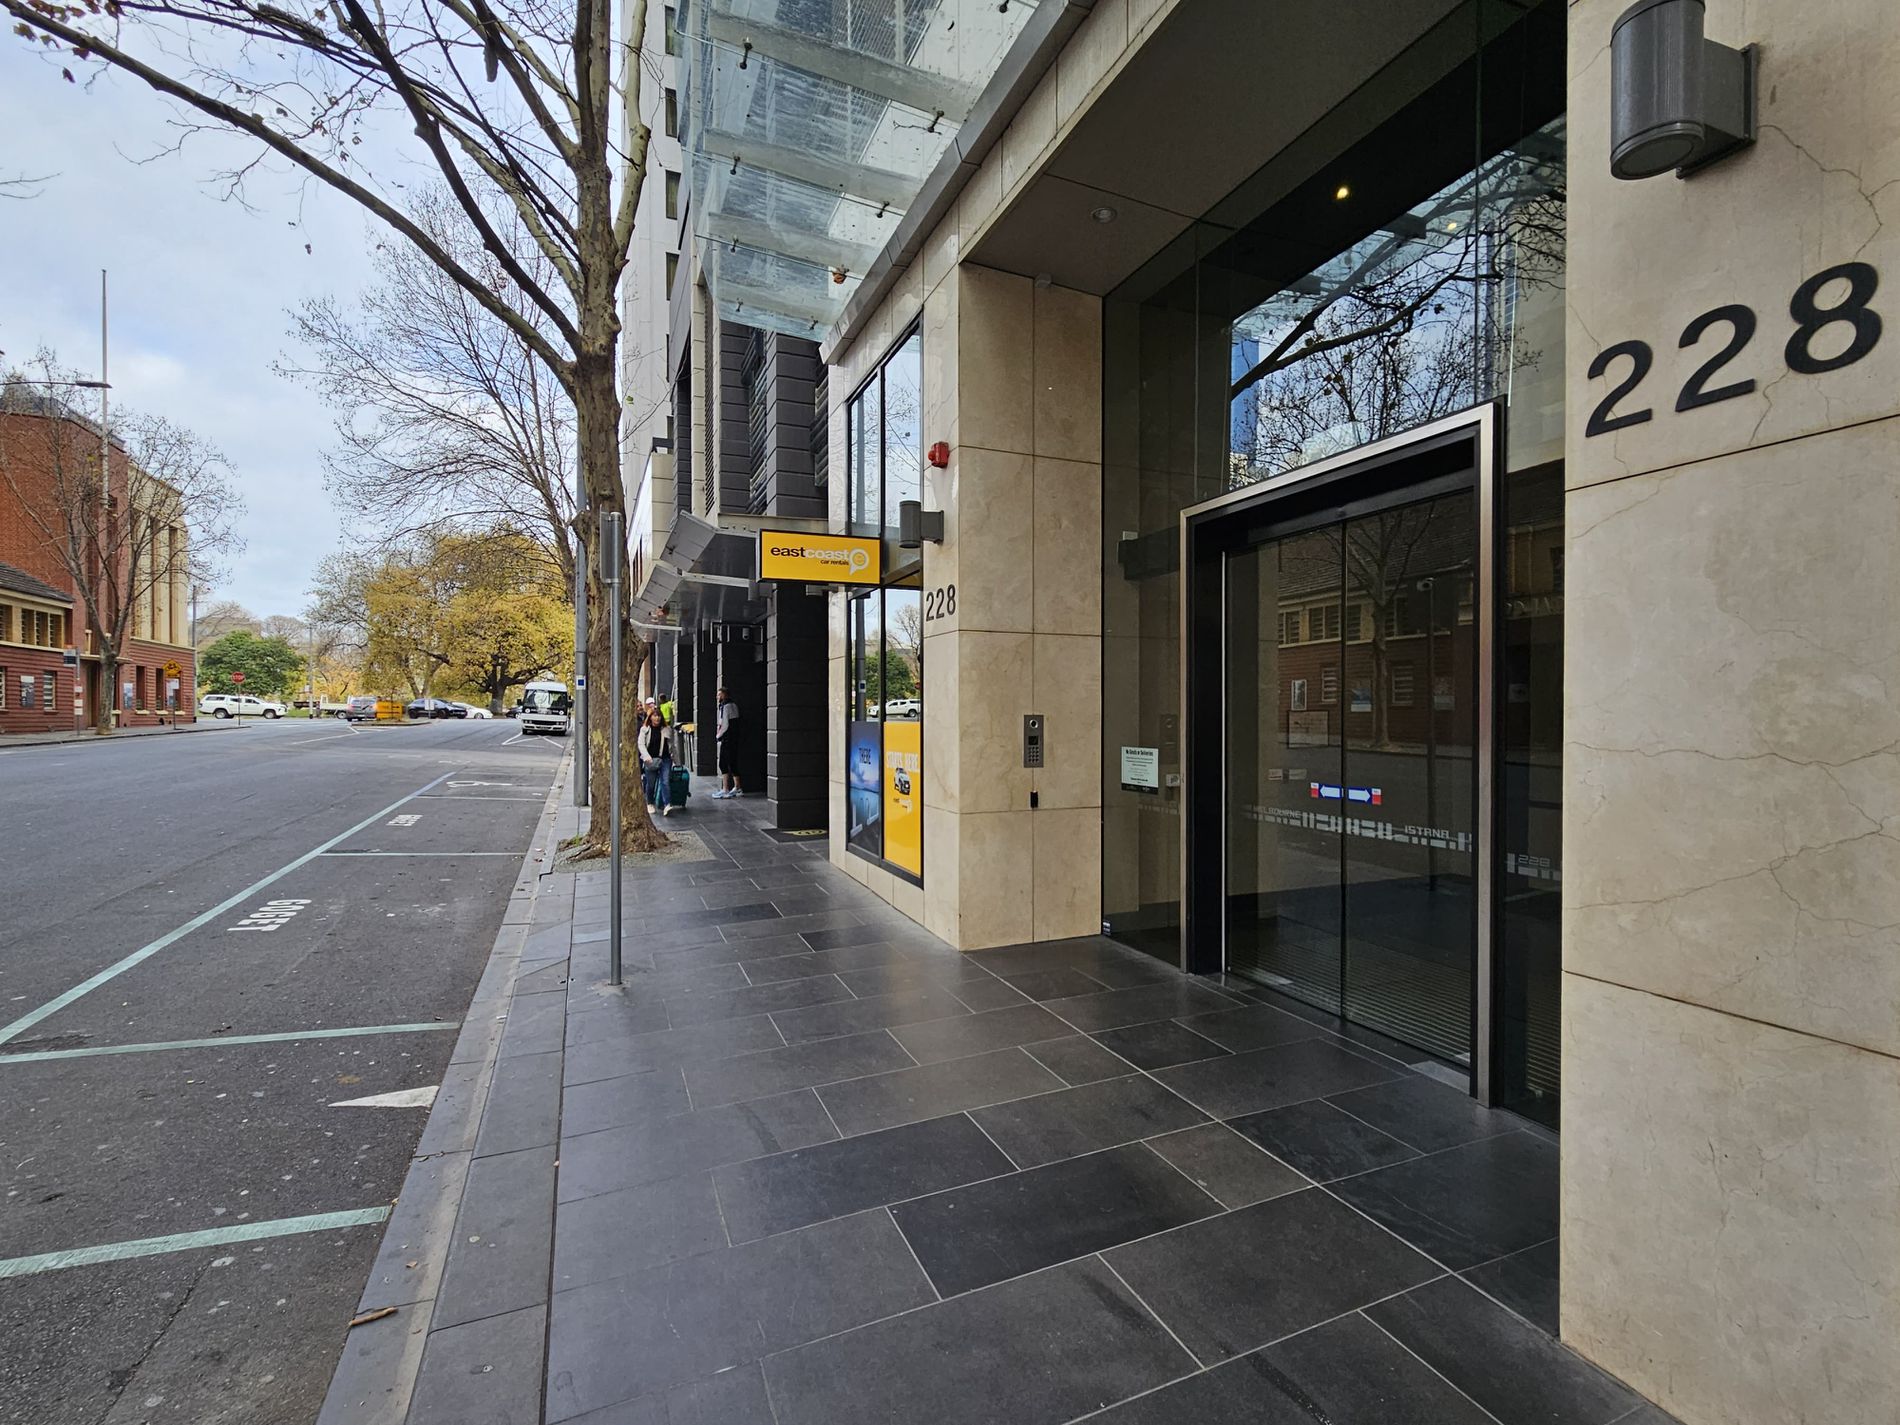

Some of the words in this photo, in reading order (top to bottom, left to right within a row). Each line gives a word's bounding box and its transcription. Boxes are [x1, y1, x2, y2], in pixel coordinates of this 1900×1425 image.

[1585, 262, 1883, 438] 228
[925, 583, 957, 622] 228
[1404, 824, 1450, 840] ISTANA
[1518, 854, 1551, 868] 228
[227, 898, 312, 932] GOGET
